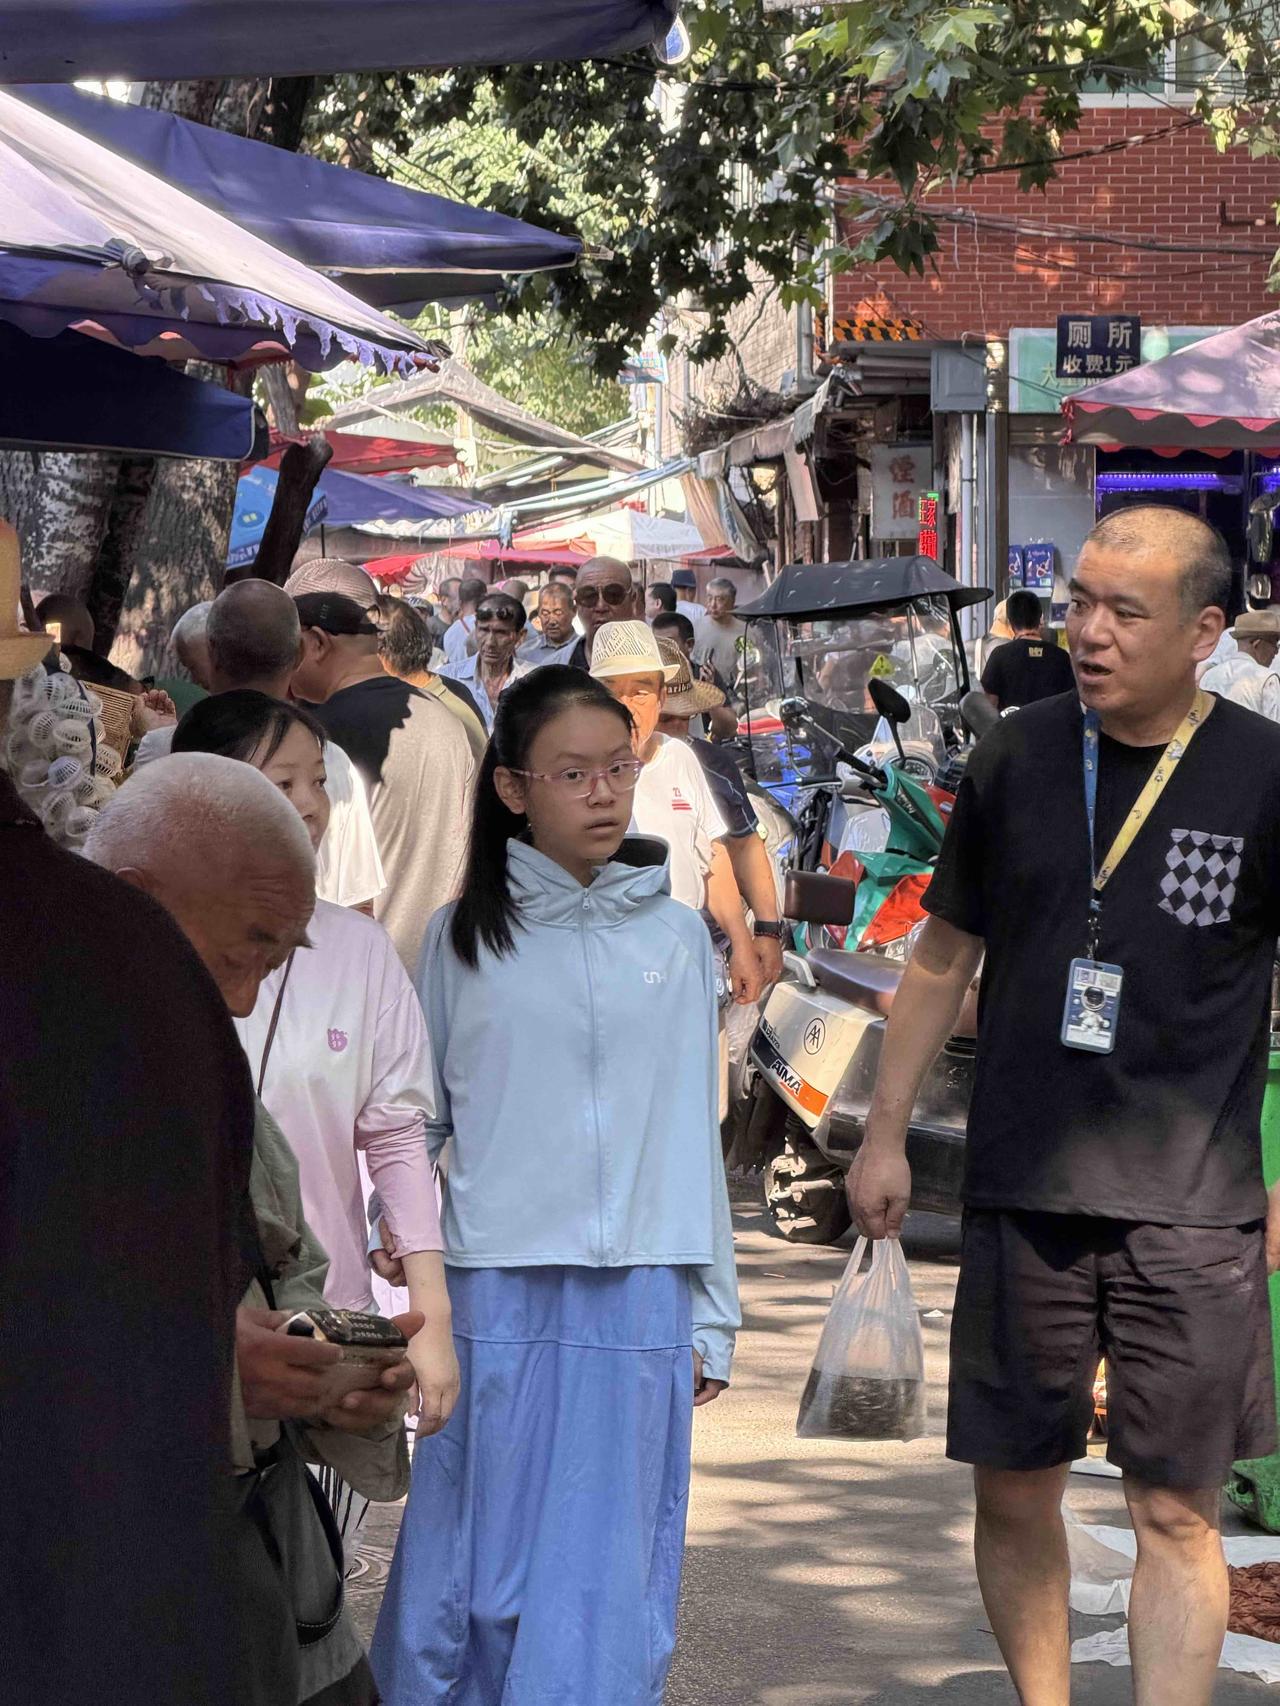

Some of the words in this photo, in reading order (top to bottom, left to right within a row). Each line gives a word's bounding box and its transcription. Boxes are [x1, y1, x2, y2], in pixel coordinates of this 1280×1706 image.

[1067, 321, 1133, 349] 厕所
[1062, 354, 1133, 374] 收费1元
[771, 1060, 802, 1096] AIMA
